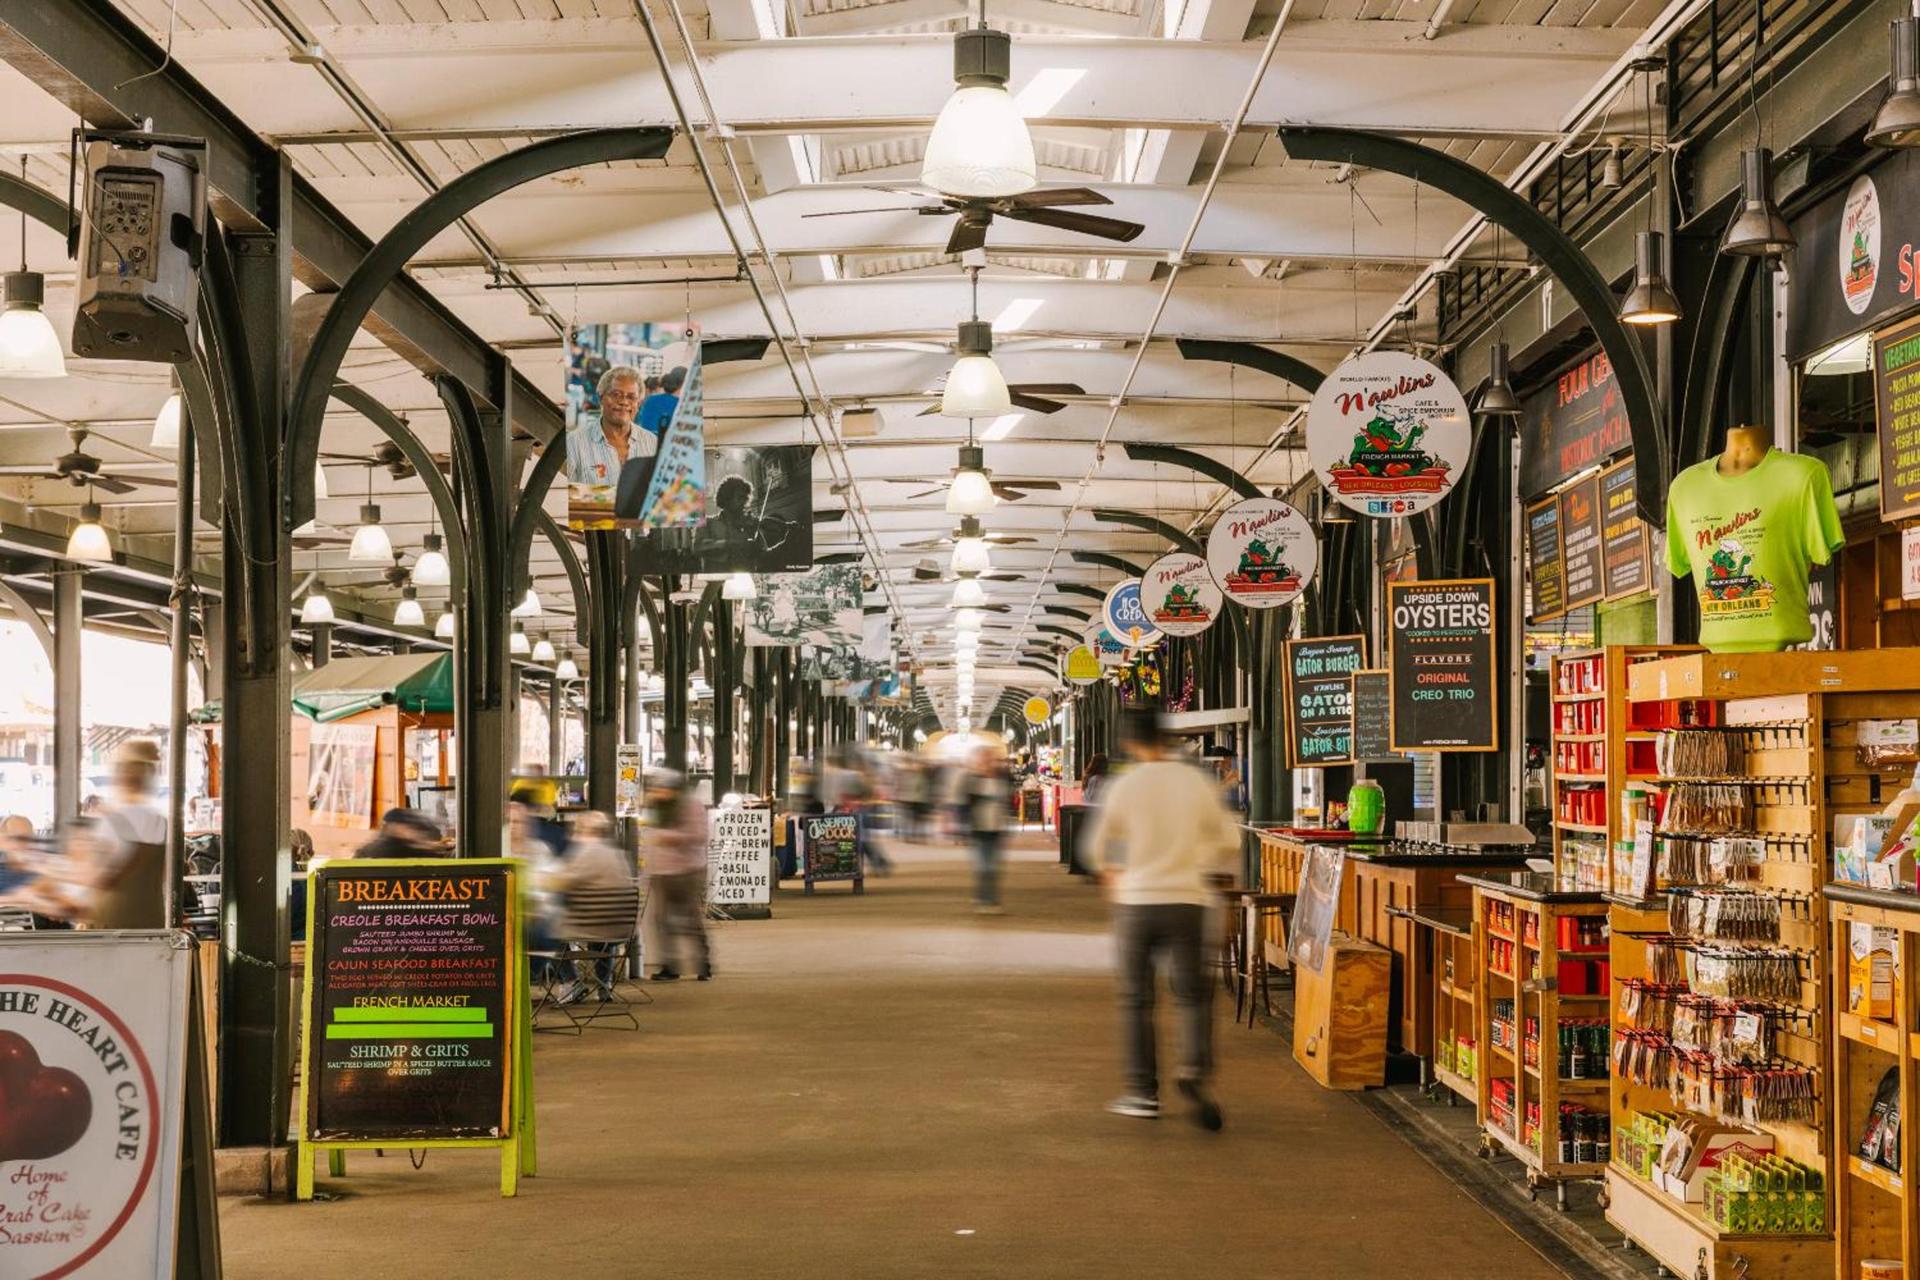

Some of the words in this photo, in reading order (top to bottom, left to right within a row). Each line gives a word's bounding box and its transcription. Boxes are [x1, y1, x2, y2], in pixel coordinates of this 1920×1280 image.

[1559, 363, 1589, 408] FOUR
[1121, 597, 1141, 610] HO
[1403, 593, 1443, 605] UPSIDE
[1445, 591, 1480, 603] DOWN
[1721, 599, 1762, 610] ORLEANS
[1115, 608, 1147, 621] CREP
[1393, 602, 1491, 630] OYSTERS
[1295, 657, 1323, 677] GATOR
[1325, 653, 1361, 674] BURGER
[1415, 655, 1471, 664] FLAVORS
[1416, 673, 1471, 684] ORIGINAL
[1411, 690, 1444, 701] CREO
[1447, 688, 1475, 700] TRIO
[1300, 707, 1316, 719] ON
[1318, 707, 1326, 716] A
[1329, 705, 1353, 715] STIC
[1301, 737, 1333, 757] GATOR
[1335, 735, 1352, 753] BIT
[723, 813, 763, 824] FROZEN
[719, 826, 733, 837] OR
[737, 826, 759, 837] ICED
[722, 863, 751, 874] BASIL
[337, 878, 491, 903] BREAKFAST
[721, 888, 745, 899] ICED
[750, 888, 756, 898] T
[330, 914, 382, 927] CREOLE
[384, 913, 460, 926] BREAKFAST
[462, 912, 499, 926] BOWL
[352, 938, 380, 946] BACON
[438, 937, 475, 945] SAUSAGE
[327, 959, 369, 970] CAJUN
[371, 959, 428, 970] SEAFOOD
[430, 957, 499, 969] BREAKFAST
[353, 995, 408, 1008] FRENCH
[411, 995, 472, 1008] MARKET
[350, 1045, 408, 1058] SHRIMP
[410, 1045, 423, 1057] &
[425, 1043, 470, 1057] GRITS
[363, 1061, 392, 1069] SHRIMP
[437, 1060, 467, 1068] BUTTER
[467, 1059, 492, 1067] SAUCE
[0, 991, 40, 1015] HE
[44, 998, 129, 1076] HEART
[114, 1080, 141, 1161] CAFE
[387, 1068, 409, 1076] OVER
[409, 1068, 432, 1076] GRITS
[10, 1164, 70, 1185] Home
[27, 1182, 51, 1207] of
[40, 1201, 91, 1223] Cake
